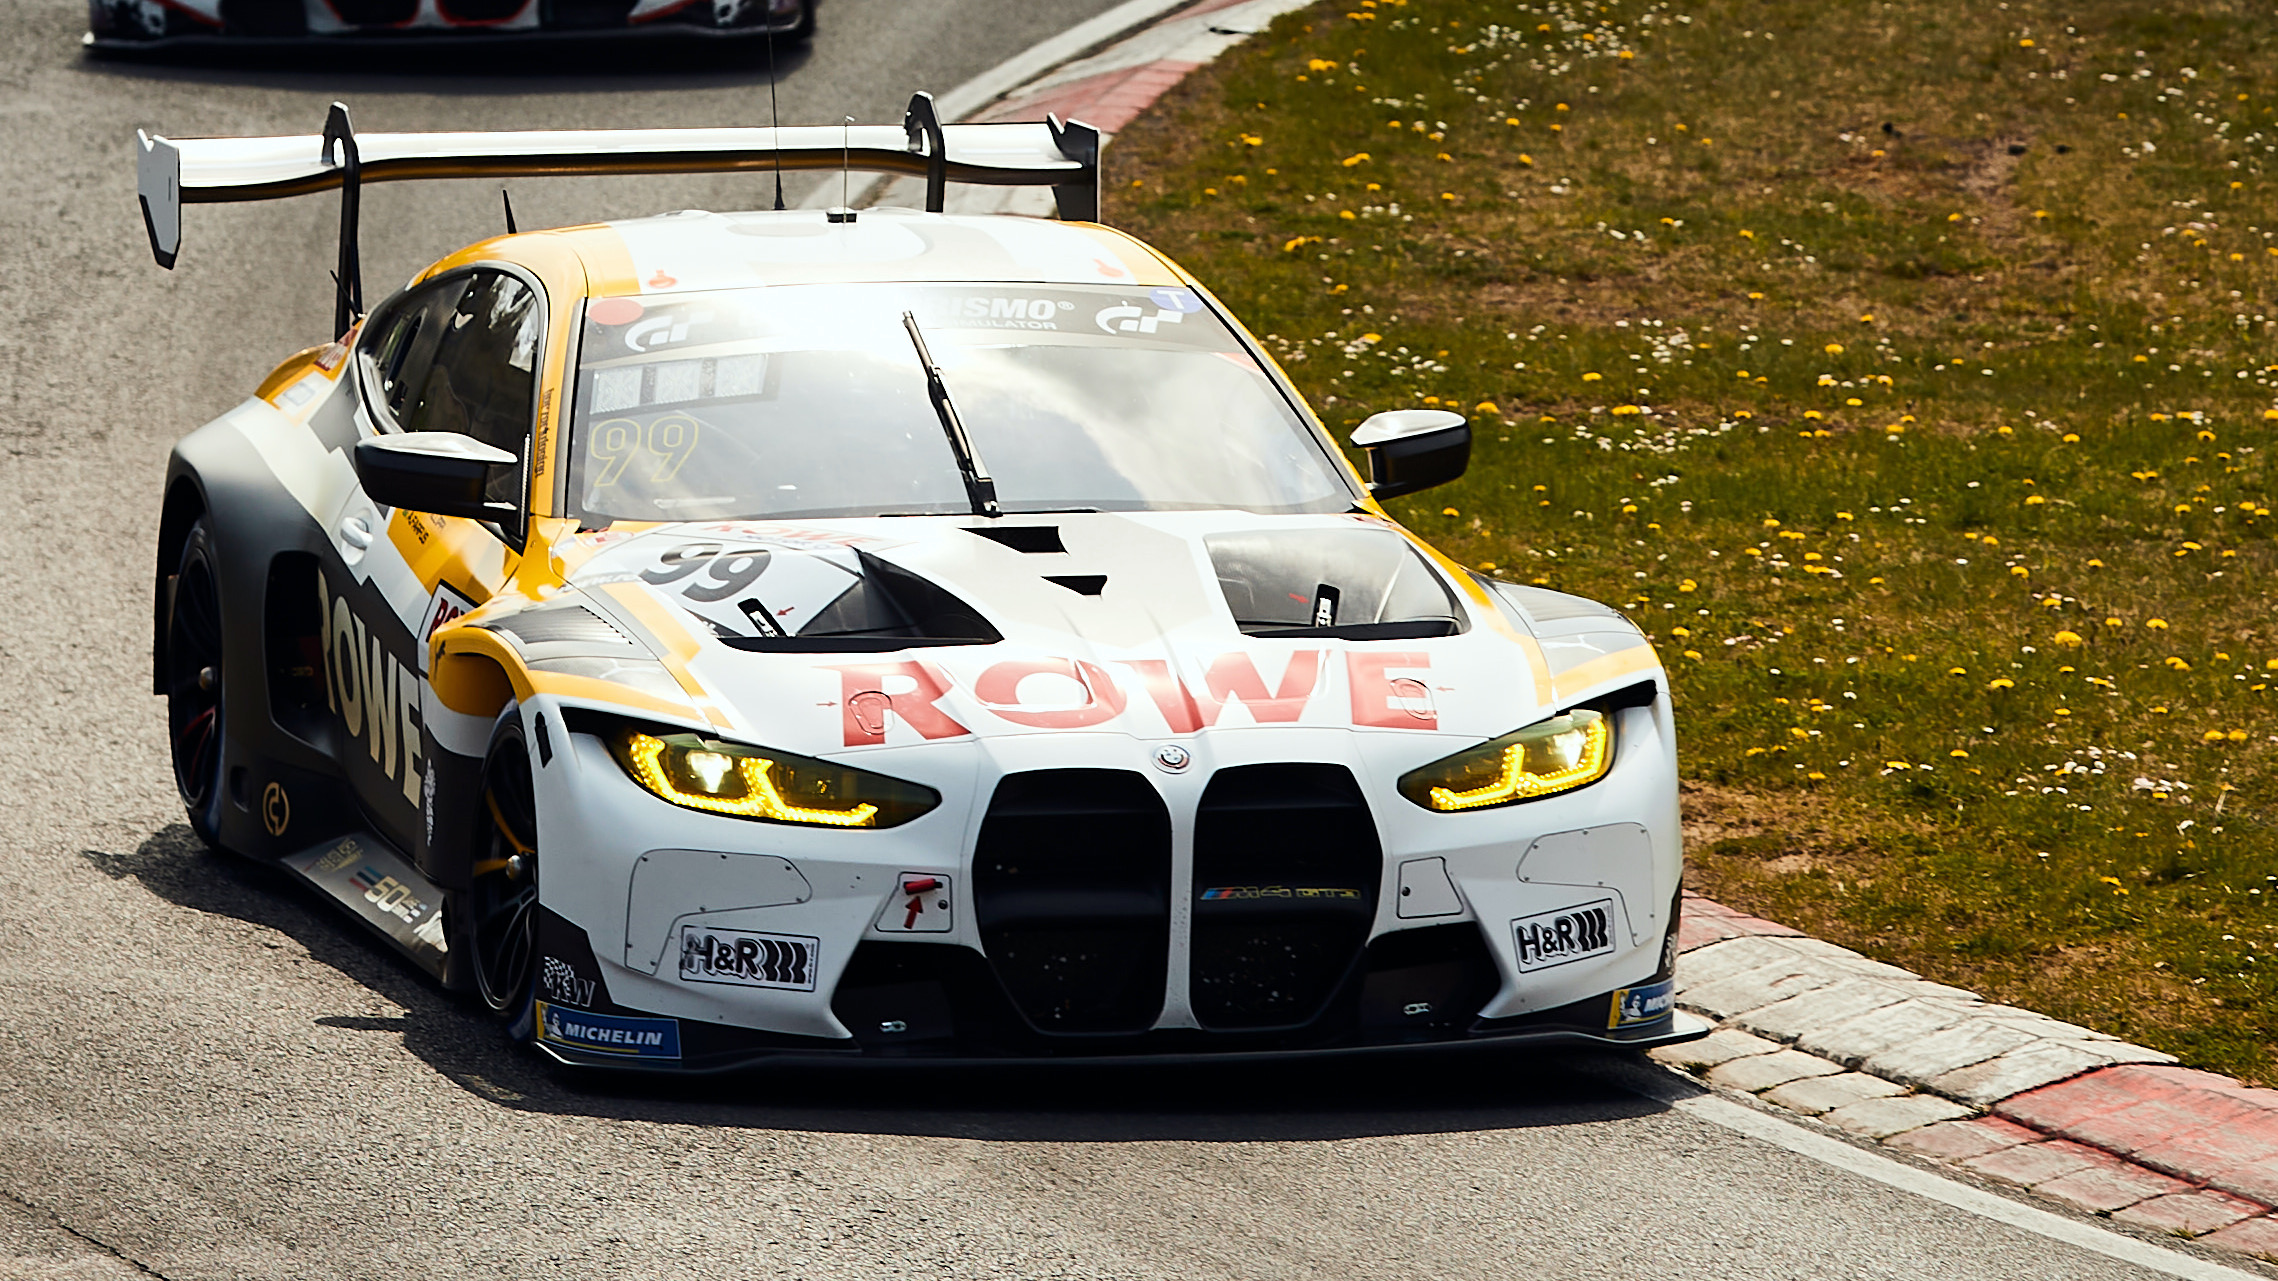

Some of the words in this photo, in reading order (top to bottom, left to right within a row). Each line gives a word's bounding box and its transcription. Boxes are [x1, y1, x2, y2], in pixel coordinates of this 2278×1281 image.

[590, 418, 699, 487] 99
[639, 543, 772, 603] 99
[812, 648, 1440, 747] ROWE
[685, 934, 764, 981] H&R
[1516, 915, 1577, 965] H&R
[564, 1021, 664, 1046] MICHELIN
